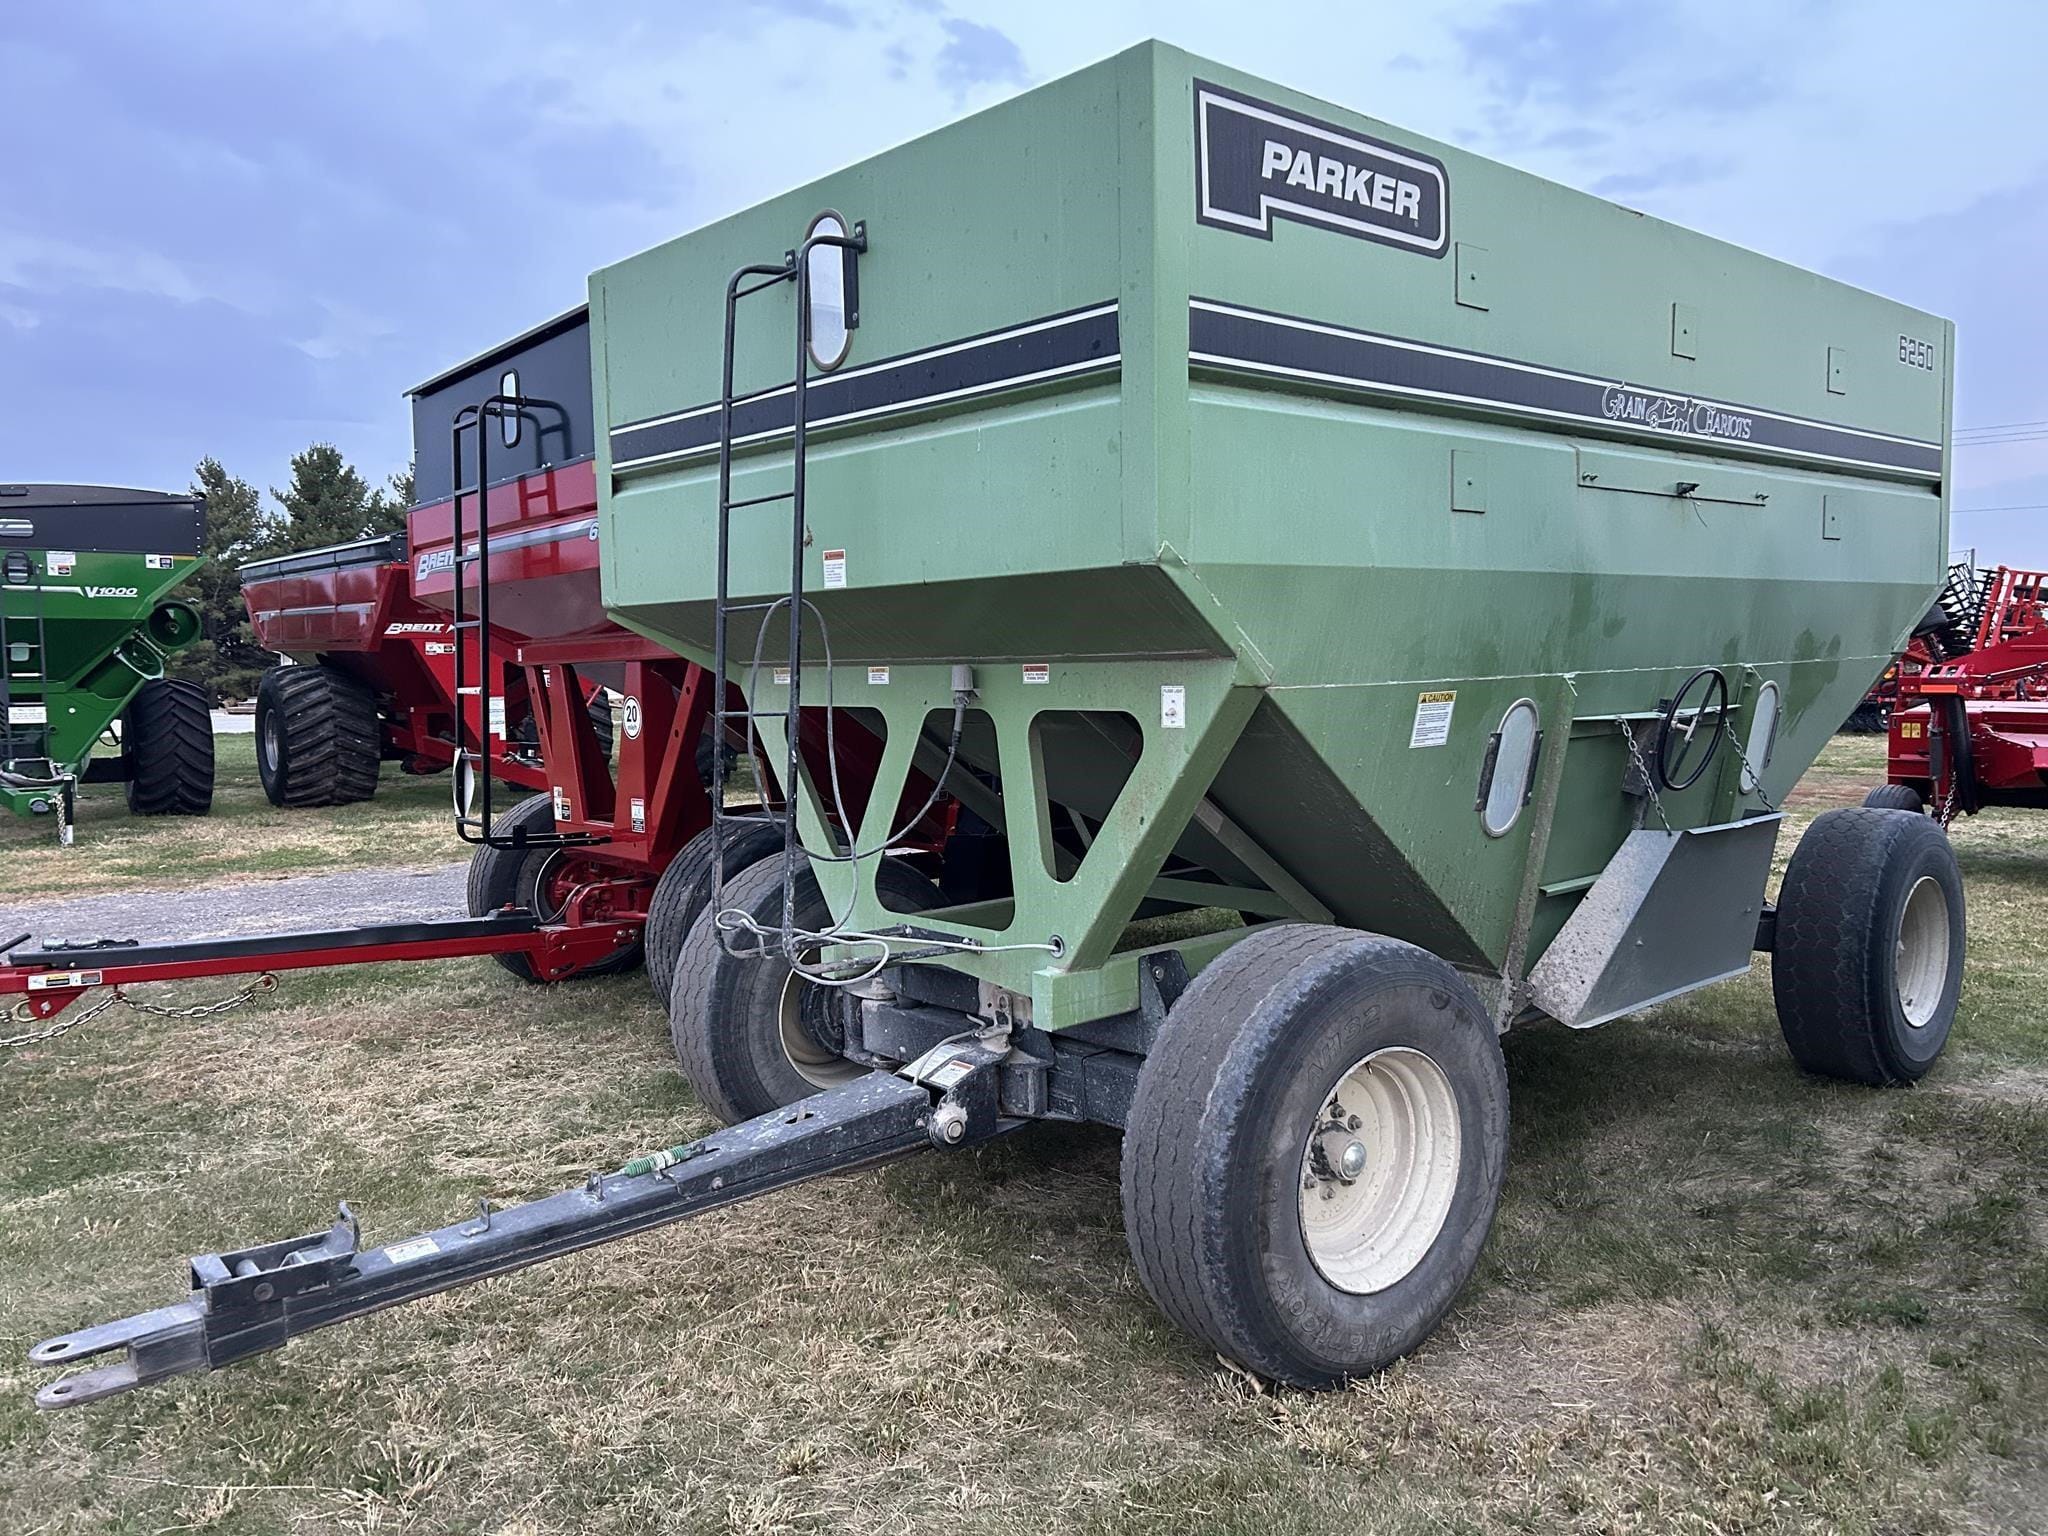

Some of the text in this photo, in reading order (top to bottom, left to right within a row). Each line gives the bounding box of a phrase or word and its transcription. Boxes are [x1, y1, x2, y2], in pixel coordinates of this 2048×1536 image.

[1261, 139, 1421, 220] PARKER
[1898, 333, 1935, 372] 6250
[1693, 404, 1752, 439] CHARIOTS
[415, 550, 457, 581] BREN
[84, 586, 139, 598] V1000
[384, 623, 445, 635] BRENT
[1428, 693, 1454, 703] CAUTION
[626, 705, 638, 723] 20
